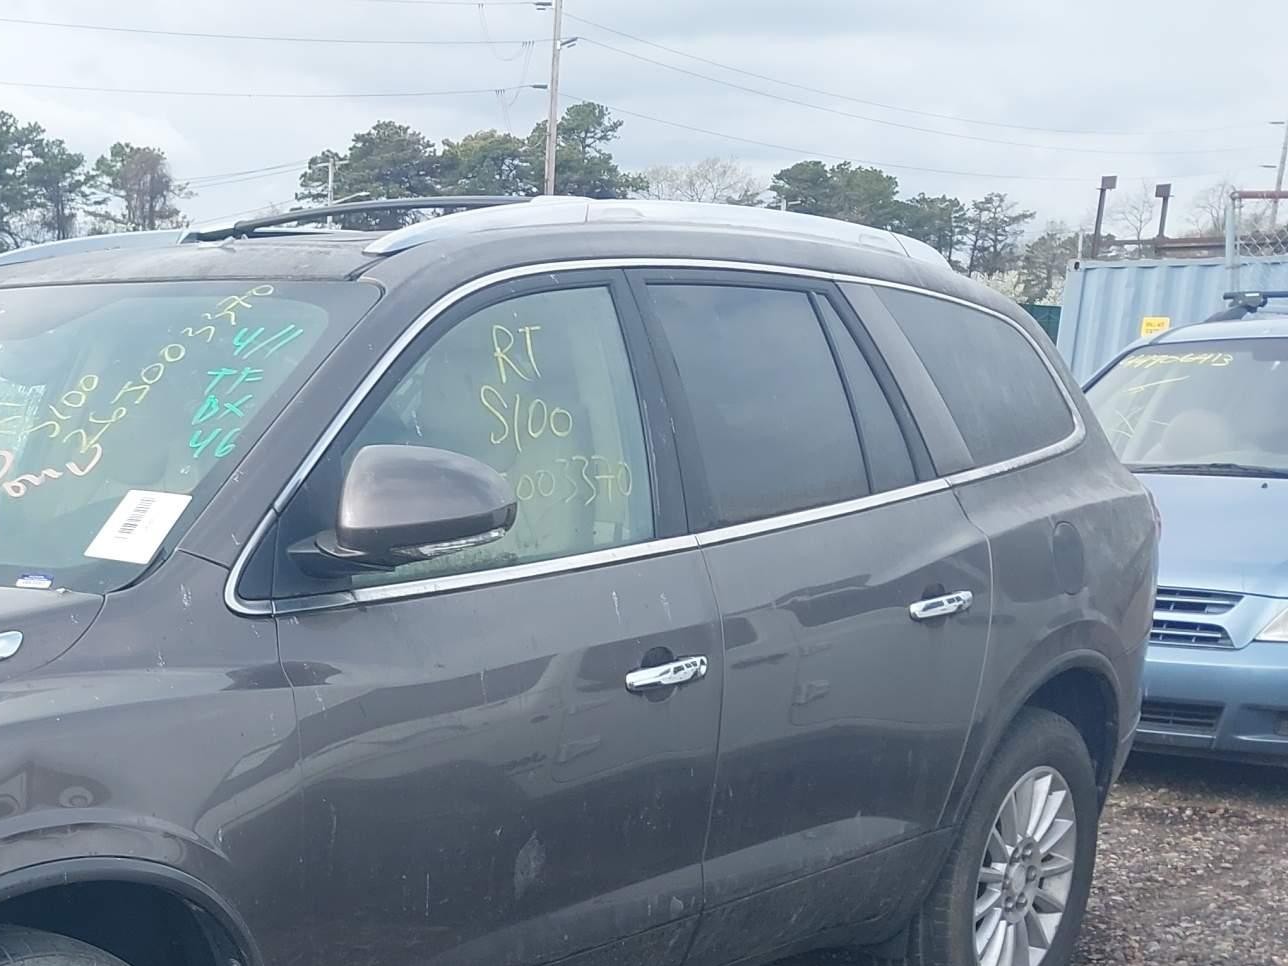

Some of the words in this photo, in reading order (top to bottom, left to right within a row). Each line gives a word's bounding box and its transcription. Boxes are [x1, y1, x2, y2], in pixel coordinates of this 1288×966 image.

[491, 324, 543, 383] RT
[204, 366, 265, 396] TF
[480, 384, 574, 453] S100
[188, 427, 242, 459] 46
